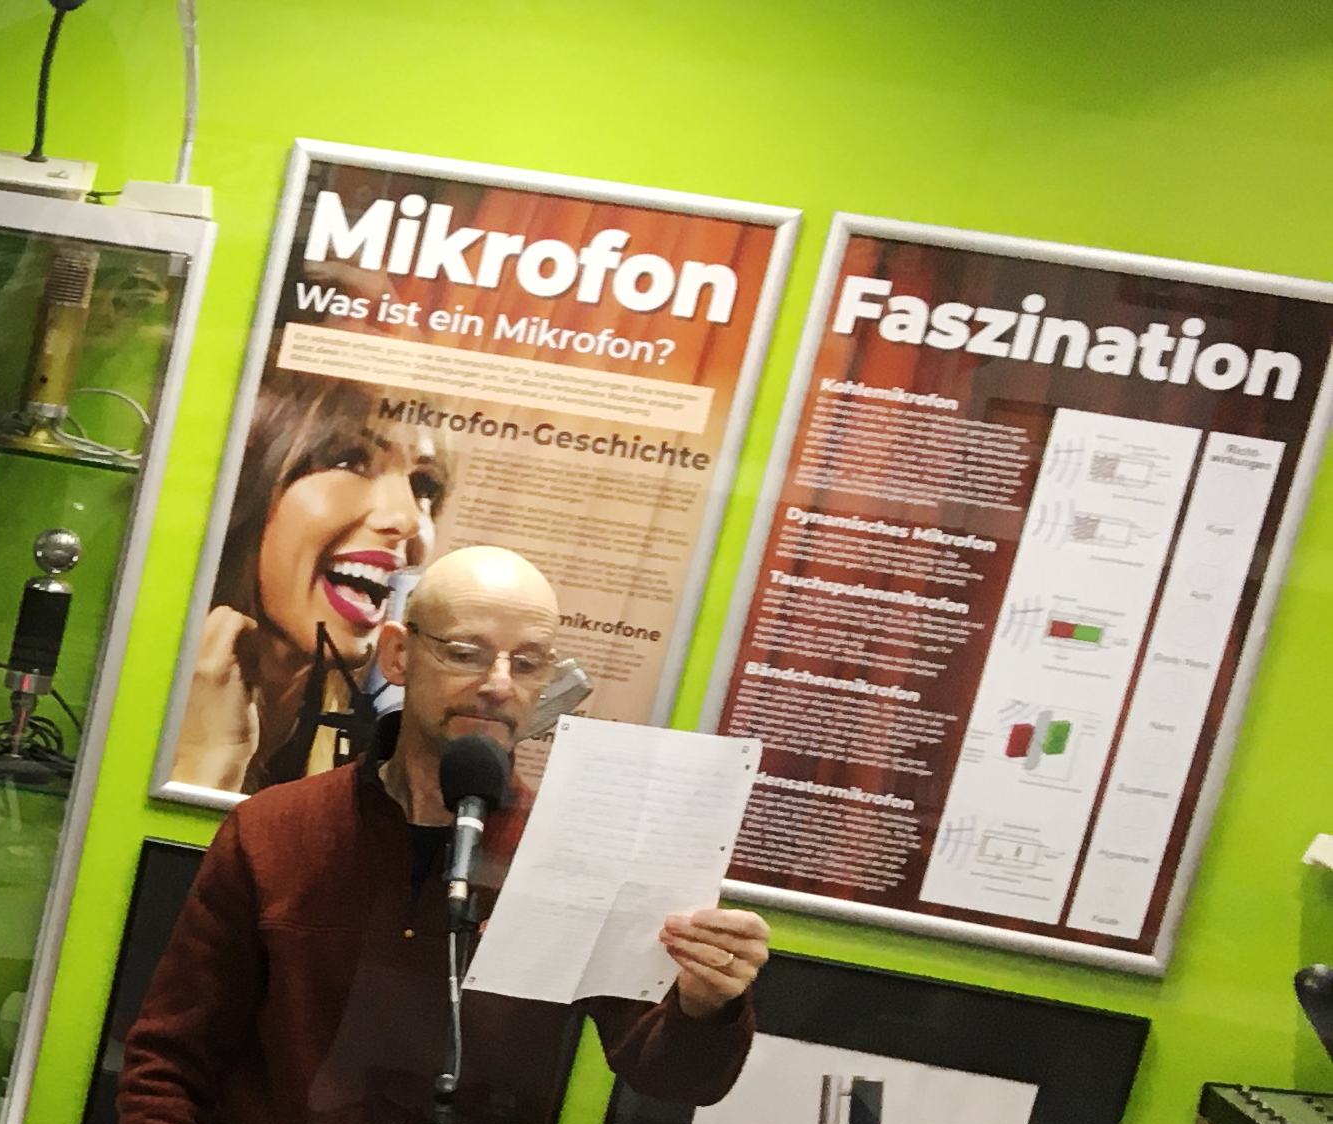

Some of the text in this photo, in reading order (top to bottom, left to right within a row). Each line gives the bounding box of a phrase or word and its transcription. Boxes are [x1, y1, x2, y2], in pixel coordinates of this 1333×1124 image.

[303, 190, 738, 323] Mikrofon
[295, 283, 676, 366] Was ist ein Mikrofon?
[831, 274, 1302, 401] Faszination
[819, 377, 959, 411] Kohlemikrofon
[377, 397, 711, 472] Mikrofon-Geschichte
[786, 506, 997, 552] Dynamisches Mikrofon
[770, 569, 970, 614] Tauchspulenmikrofon
[558, 613, 662, 642] mikrofone
[744, 661, 921, 702] Bändchenmikrofon
[755, 771, 915, 811] densatormikrofon
